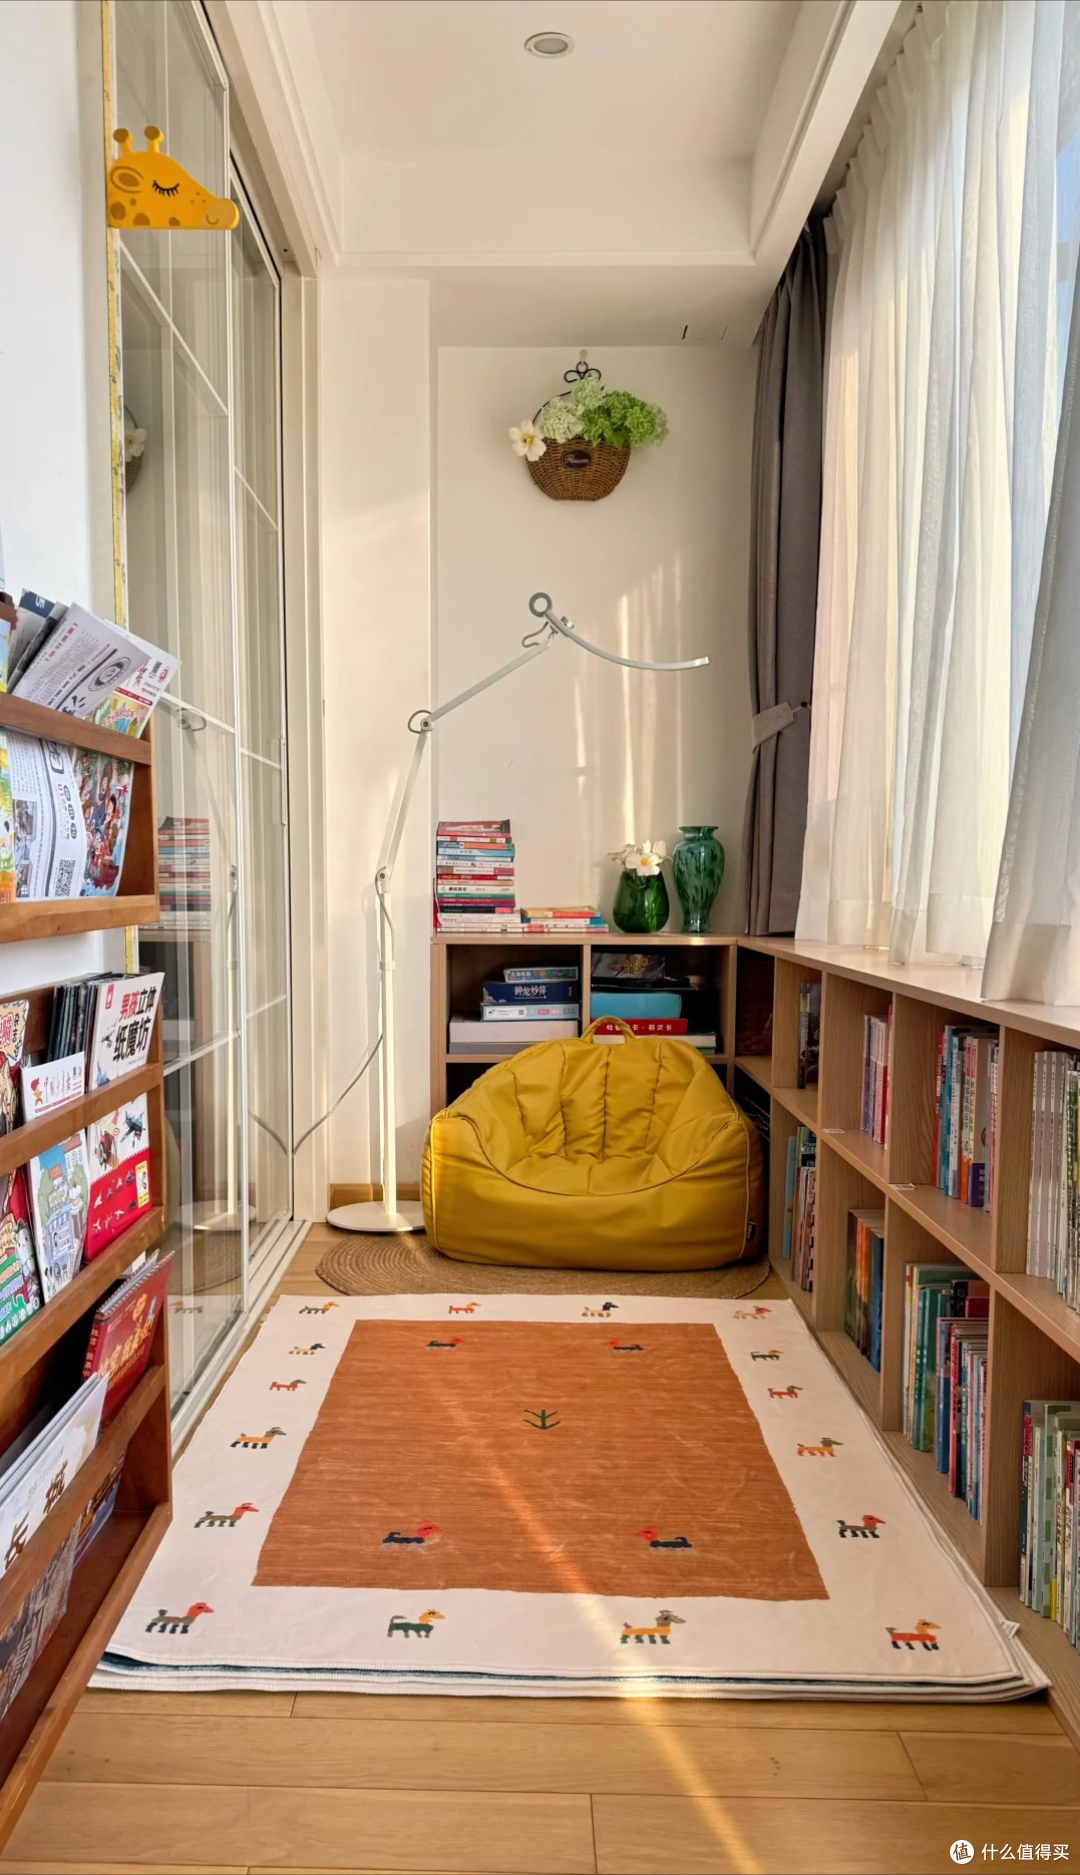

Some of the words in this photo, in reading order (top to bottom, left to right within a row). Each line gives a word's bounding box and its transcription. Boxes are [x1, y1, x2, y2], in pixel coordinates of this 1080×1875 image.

[119, 986, 157, 1022] 男孩立体
[113, 1016, 151, 1062] 纸魔坊
